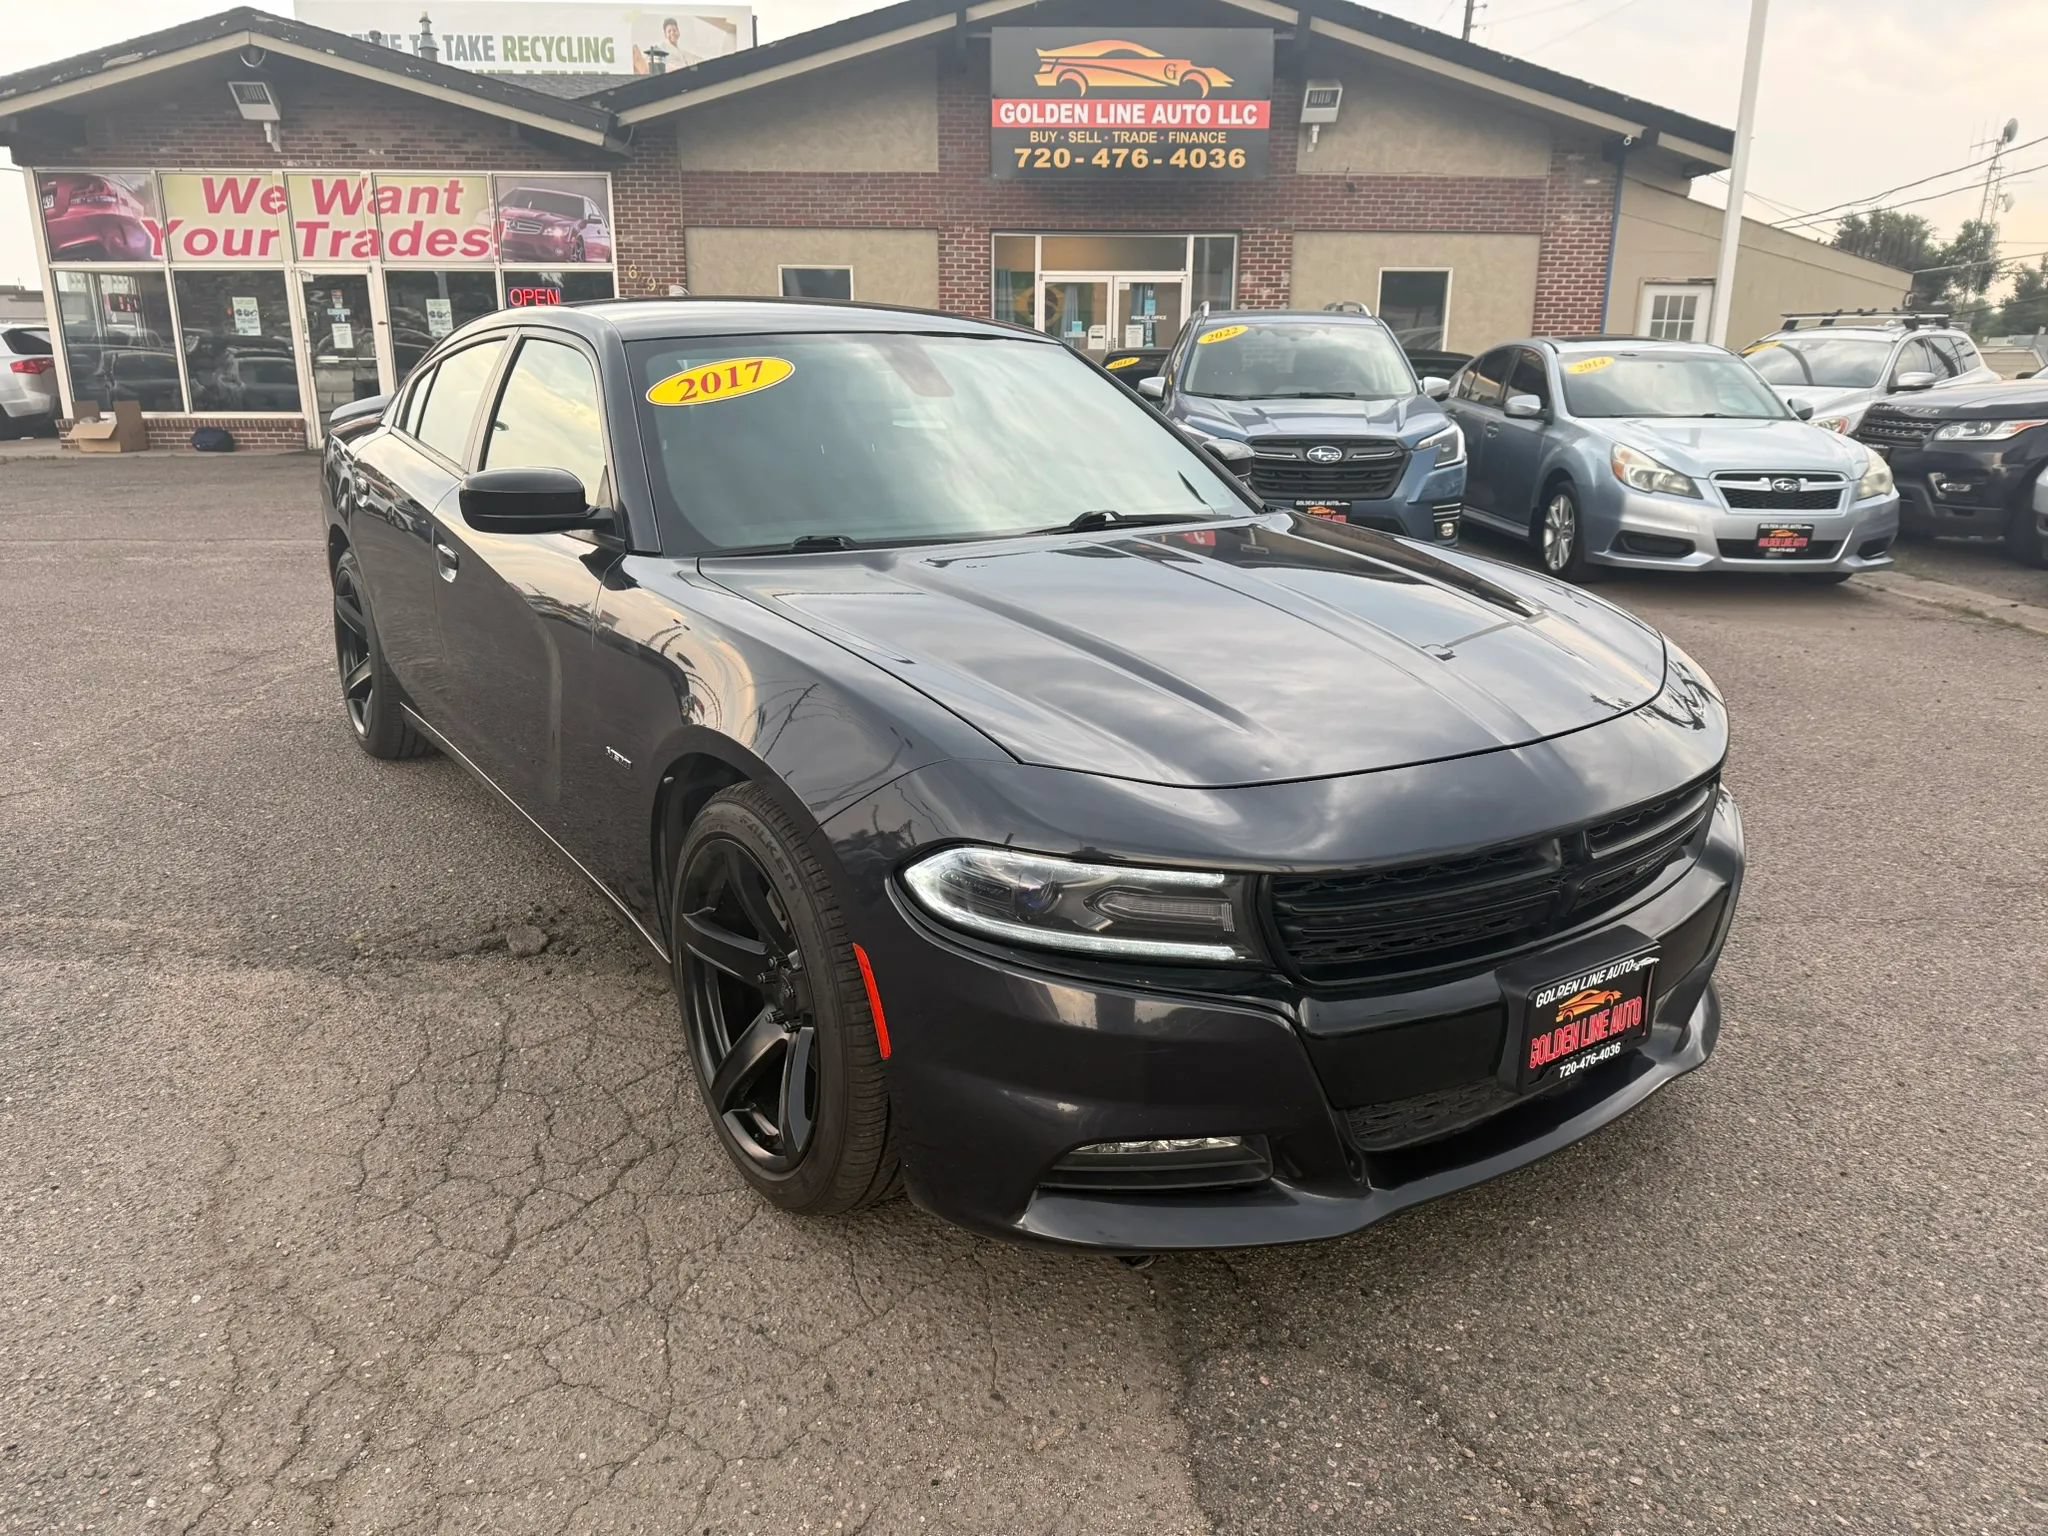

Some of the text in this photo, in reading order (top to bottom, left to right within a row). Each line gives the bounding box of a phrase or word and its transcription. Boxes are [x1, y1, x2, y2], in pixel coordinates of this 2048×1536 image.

[442, 35, 495, 62] TAKE
[502, 36, 615, 63] RECYCLING
[1164, 63, 1178, 80] G
[999, 103, 1258, 125] GOLDEN LINE AUTO LLC
[1030, 131, 1227, 143] BUY SELL TRADE FINANCE
[1014, 148, 1246, 169] 720-476-4036
[202, 177, 464, 215] We Want
[142, 219, 506, 258] Your Trades!
[509, 288, 560, 307] OPEN
[1207, 326, 1239, 342] 2022
[1576, 357, 1606, 373] 2014
[676, 360, 764, 402] 2017
[1536, 959, 1635, 1008] GOLDEN LINE AUTO
[1529, 996, 1643, 1069] GOLDEN LINE AUTO
[1559, 1042, 1621, 1079] 720-476-4036
